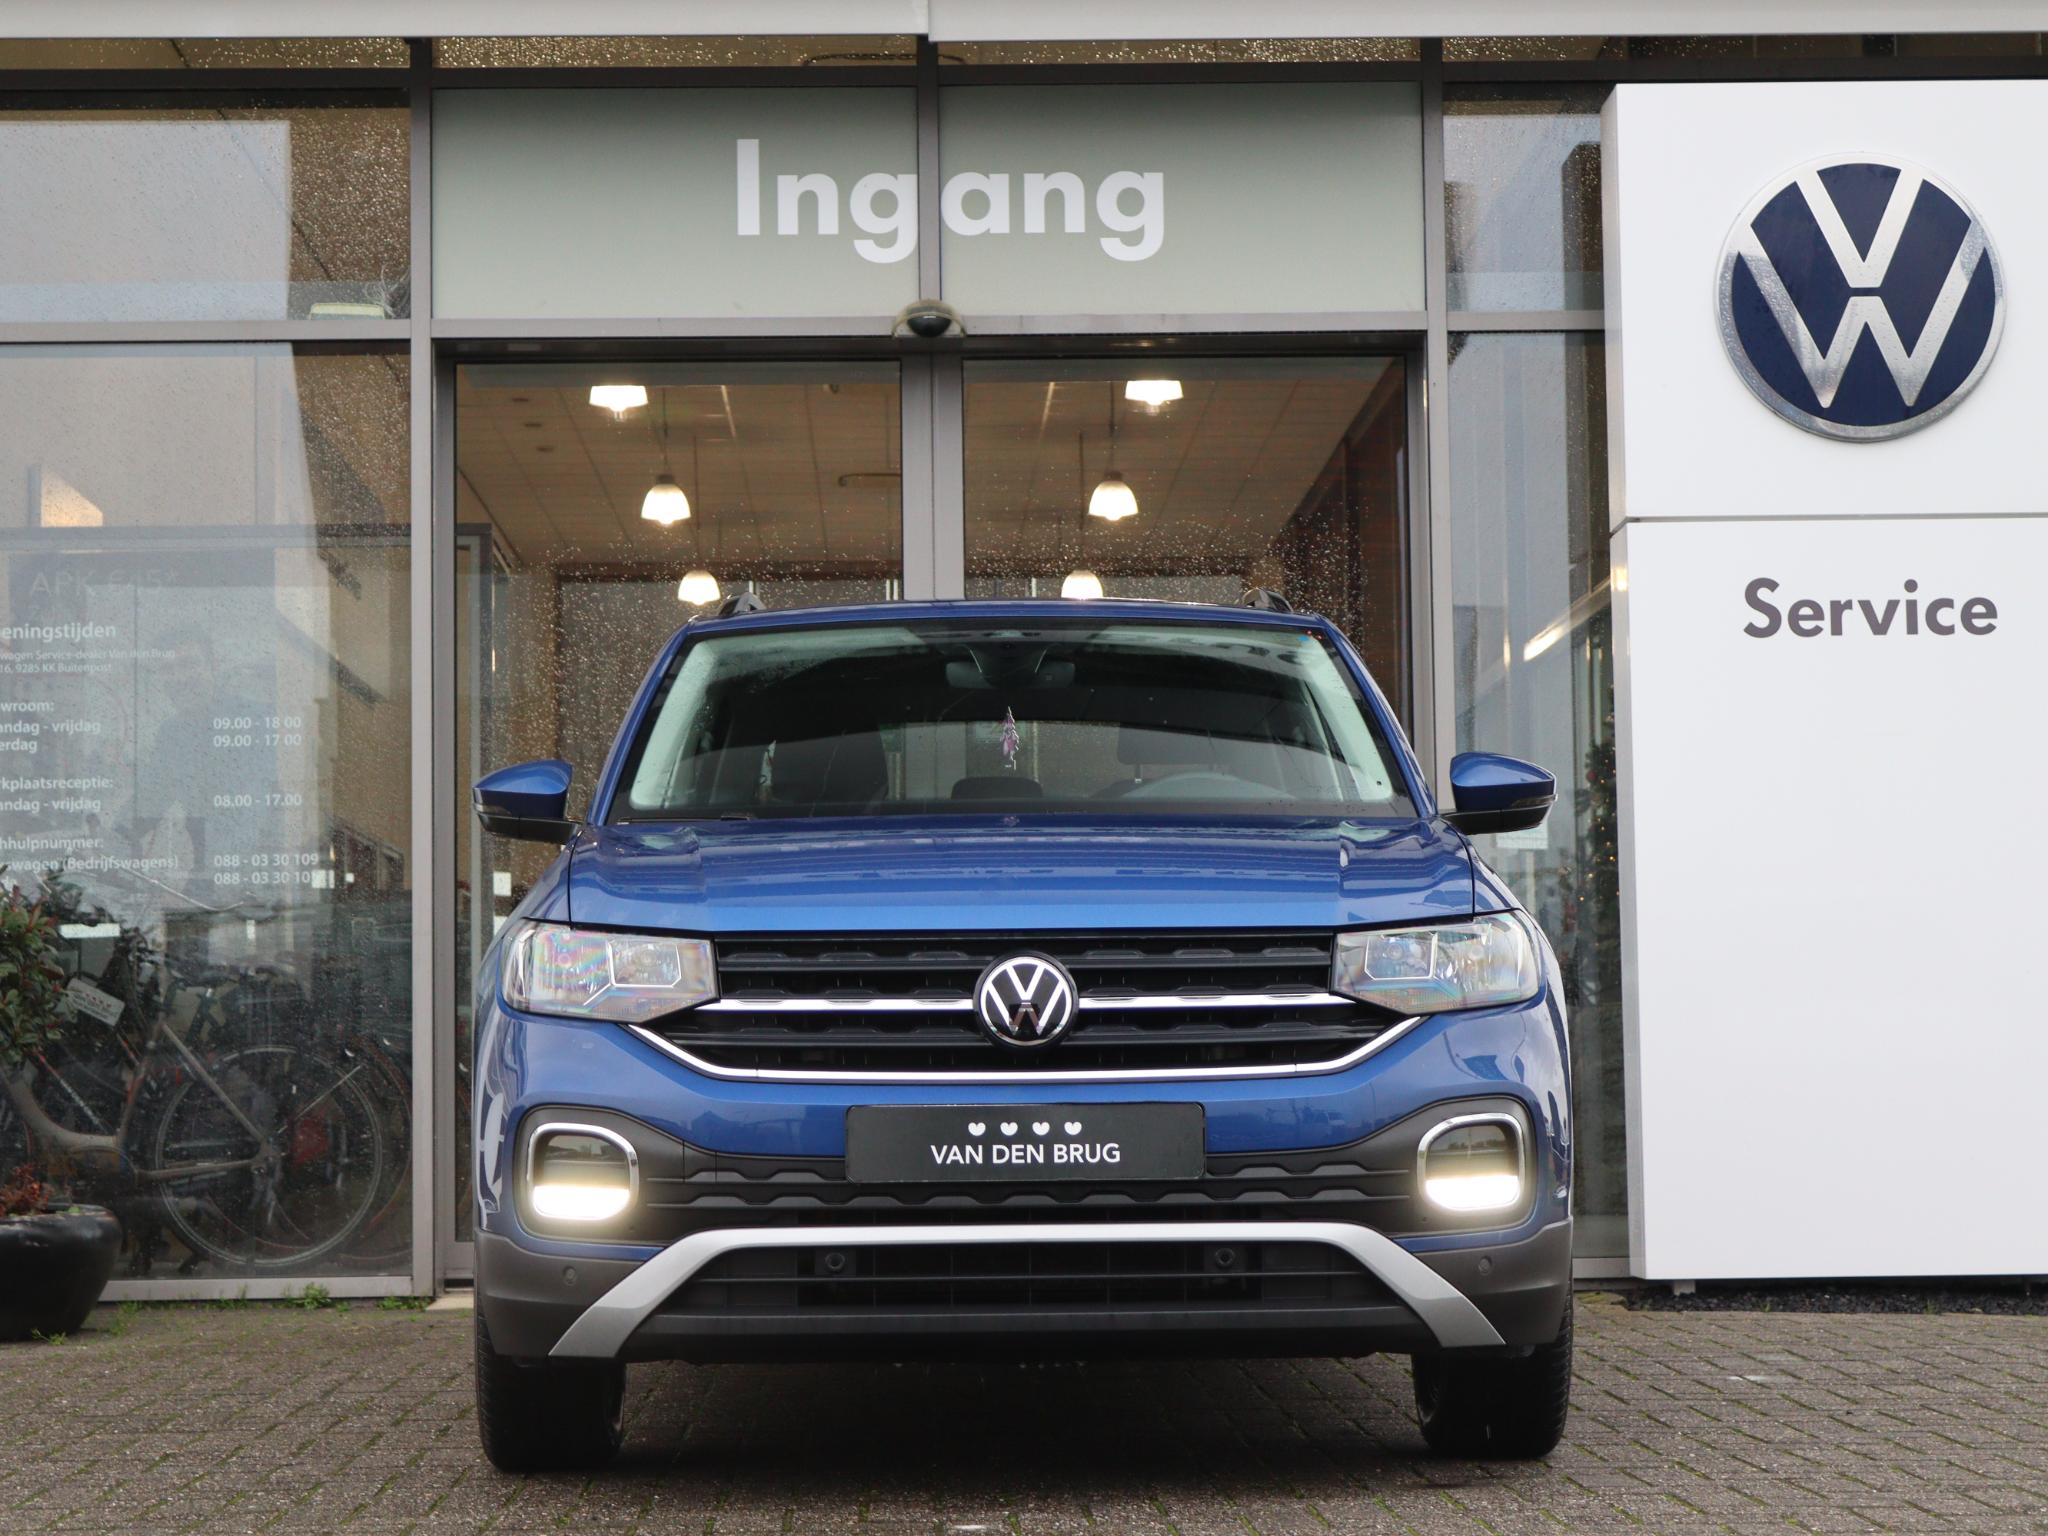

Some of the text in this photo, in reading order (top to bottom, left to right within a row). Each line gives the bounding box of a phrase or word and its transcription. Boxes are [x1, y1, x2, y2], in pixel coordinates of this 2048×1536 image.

[736, 138, 1164, 264] Ingang
[1743, 577, 1998, 639] Service
[51, 719, 101, 736] vrijdag
[213, 716, 252, 730] 09.00
[265, 716, 302, 729] 1800
[213, 734, 252, 748] 09.00
[265, 733, 302, 747] 1700
[51, 797, 101, 813] vrijdag
[213, 794, 252, 807] 08.00
[265, 793, 302, 807] 17.00
[214, 854, 240, 867] 088
[251, 853, 269, 867] 03
[273, 853, 290, 866] 30
[294, 852, 319, 866] 109
[214, 872, 240, 885] 088
[251, 871, 269, 884] 03
[273, 871, 290, 884] 30
[294, 871, 314, 884] 10
[930, 1142, 1121, 1165] VAN DEN BRUG
